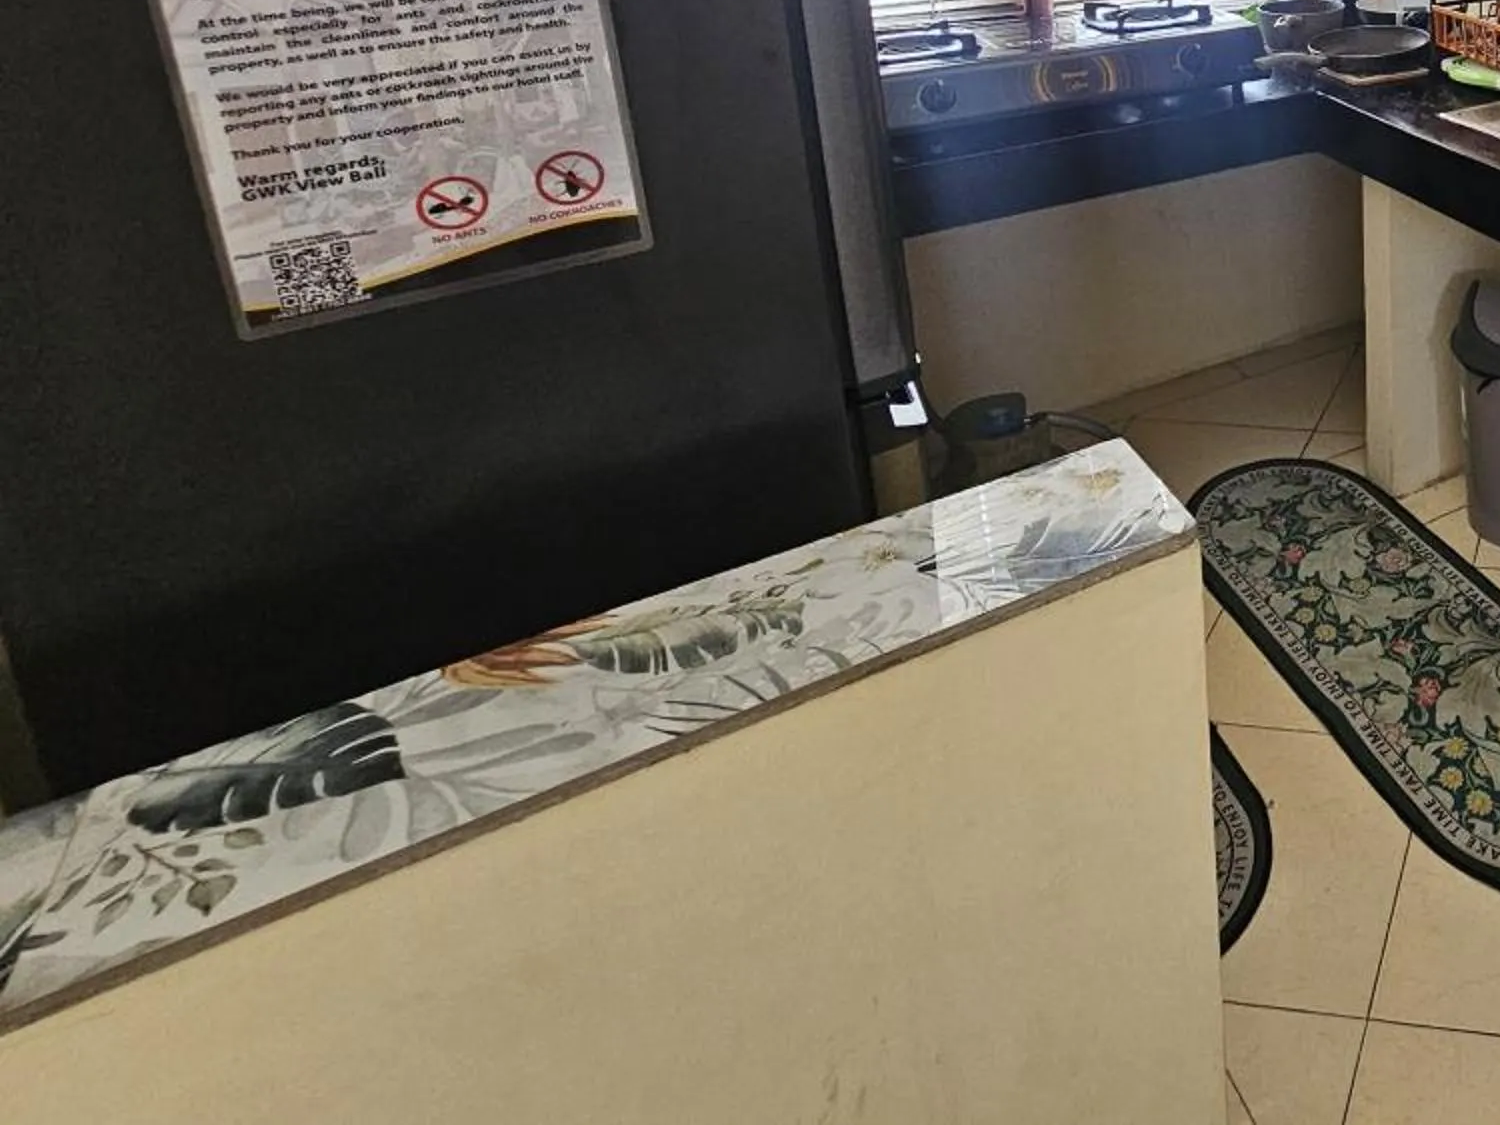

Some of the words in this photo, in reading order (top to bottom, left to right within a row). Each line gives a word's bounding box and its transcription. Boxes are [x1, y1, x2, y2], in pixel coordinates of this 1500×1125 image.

[197, 18, 215, 30] At
[219, 15, 247, 26] the
[251, 11, 286, 23] time
[344, 3, 365, 12] we
[201, 28, 260, 44] control
[273, 18, 348, 36] especially
[361, 15, 382, 24] for
[396, 9, 425, 21] ants
[438, 4, 464, 15] and
[204, 43, 276, 60] maintain
[286, 37, 312, 49] the
[321, 25, 401, 45] cleanliness
[411, 21, 437, 32] and
[446, 12, 500, 28] comfort
[508, 6, 555, 21] around
[563, 2, 584, 14] the
[287, 54, 303, 64] as
[306, 48, 337, 62] well
[340, 47, 356, 57] as
[359, 44, 374, 54] to
[377, 38, 425, 51] ensure
[429, 33, 451, 44] the
[455, 28, 496, 44] safety
[498, 24, 523, 35] and
[216, 91, 241, 103] We
[246, 83, 294, 99] would
[299, 82, 319, 91] be
[323, 76, 355, 89] very
[360, 62, 445, 85] appreciated
[462, 57, 488, 69] you
[491, 53, 515, 64] can
[520, 48, 553, 61] assist
[575, 42, 592, 53] by
[220, 99, 295, 118] reporting
[299, 95, 326, 107] any
[331, 90, 362, 101] ants
[367, 87, 381, 96] or
[385, 75, 457, 95] cockroach
[460, 67, 520, 86] sightings
[524, 58, 570, 73] around
[573, 55, 594, 66] the
[223, 114, 293, 134] property
[297, 108, 325, 121] and
[329, 102, 378, 117] inform
[381, 97, 413, 111] your
[416, 88, 472, 104] findings
[475, 84, 489, 94] to
[492, 80, 515, 91] our
[517, 75, 551, 88] hotel
[231, 146, 281, 161] Thank
[283, 141, 311, 154] you
[315, 136, 336, 148] for
[339, 131, 372, 146] your
[237, 170, 298, 188] Warm
[303, 155, 386, 178] regards,
[241, 184, 292, 202] GWK
[298, 176, 344, 193] View
[350, 166, 387, 183] Bali
[432, 233, 451, 244] NO
[454, 227, 488, 240] ANTS
[1242, 587, 1266, 612] TIME
[1465, 586, 1494, 610] TAKE
[1263, 612, 1290, 639] TAKE
[1287, 639, 1311, 665] LIFE
[1309, 665, 1345, 701] ENJOY
[1343, 700, 1363, 720] TO
[1360, 720, 1391, 758] TIME
[1390, 758, 1425, 796] TAKE
[1223, 804, 1249, 849] ENJOY
[1423, 798, 1463, 838] TIME
[1226, 856, 1250, 892] LIFE
